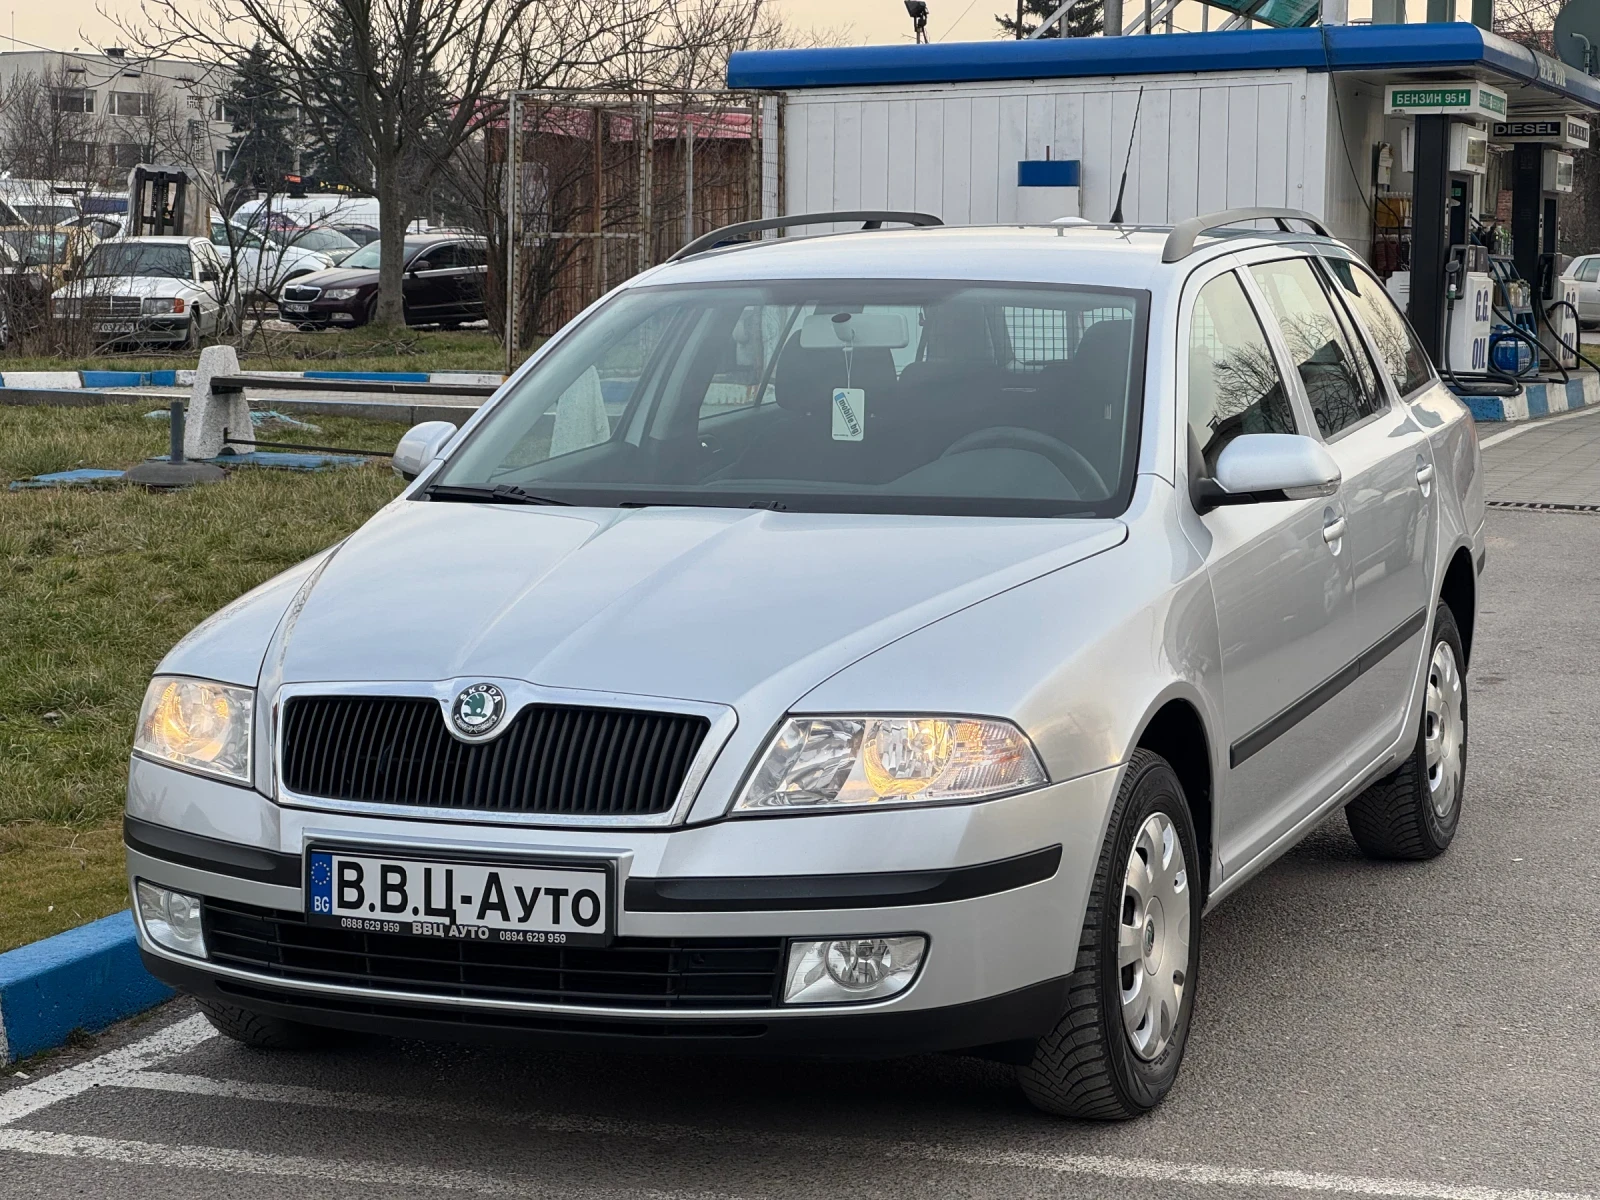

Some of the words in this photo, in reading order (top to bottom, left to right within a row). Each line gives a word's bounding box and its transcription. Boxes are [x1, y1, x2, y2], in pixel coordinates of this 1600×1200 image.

[1396, 94, 1442, 104] БЕНЗИН
[1494, 124, 1558, 135] DIESEL
[1472, 338, 1486, 370] OIL
[839, 399, 859, 435] mobile.bg
[314, 896, 330, 912] BG
[341, 917, 363, 929] 0888
[364, 920, 381, 931] 629
[383, 922, 400, 932] 959
[499, 931, 524, 941] 0894
[526, 932, 545, 942] 629
[547, 933, 566, 943] 959
